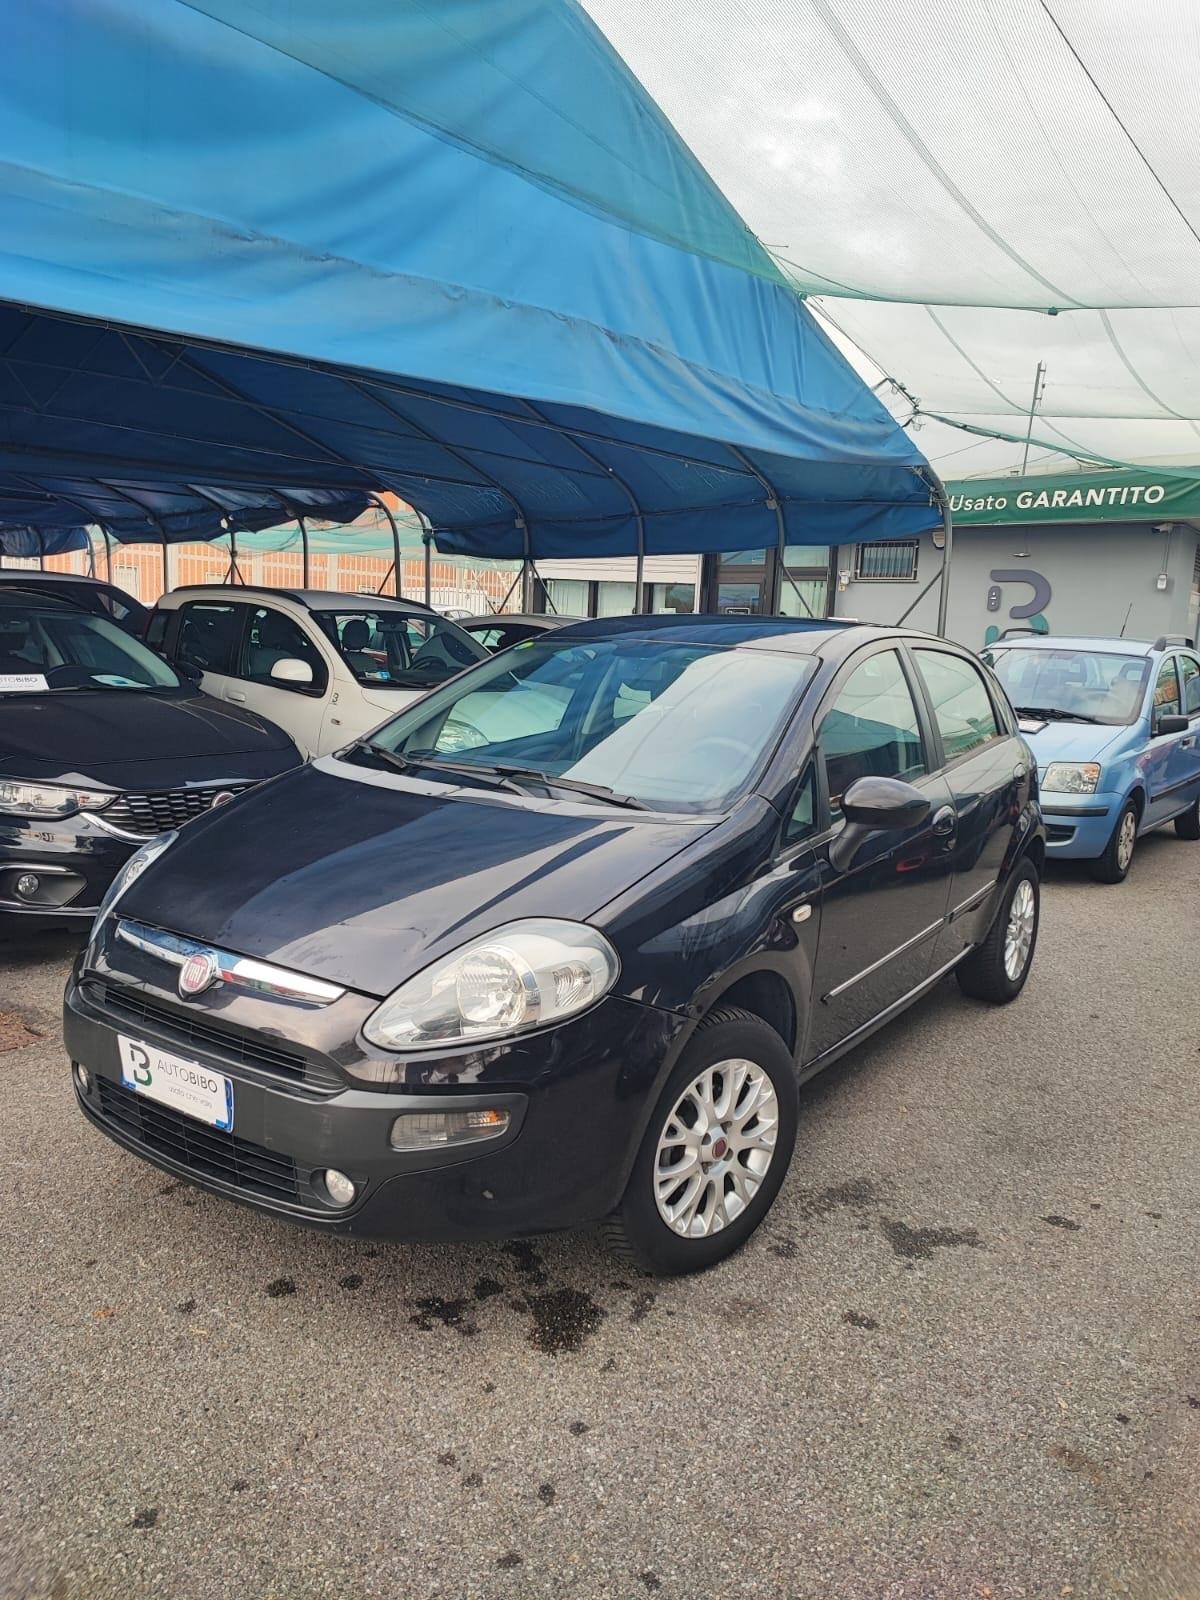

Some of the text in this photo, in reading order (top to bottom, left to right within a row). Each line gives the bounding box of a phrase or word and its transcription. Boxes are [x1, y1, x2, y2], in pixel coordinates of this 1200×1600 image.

[949, 485, 1165, 512] Usato GARANTITO
[157, 1060, 218, 1093] AUTOBIBO
